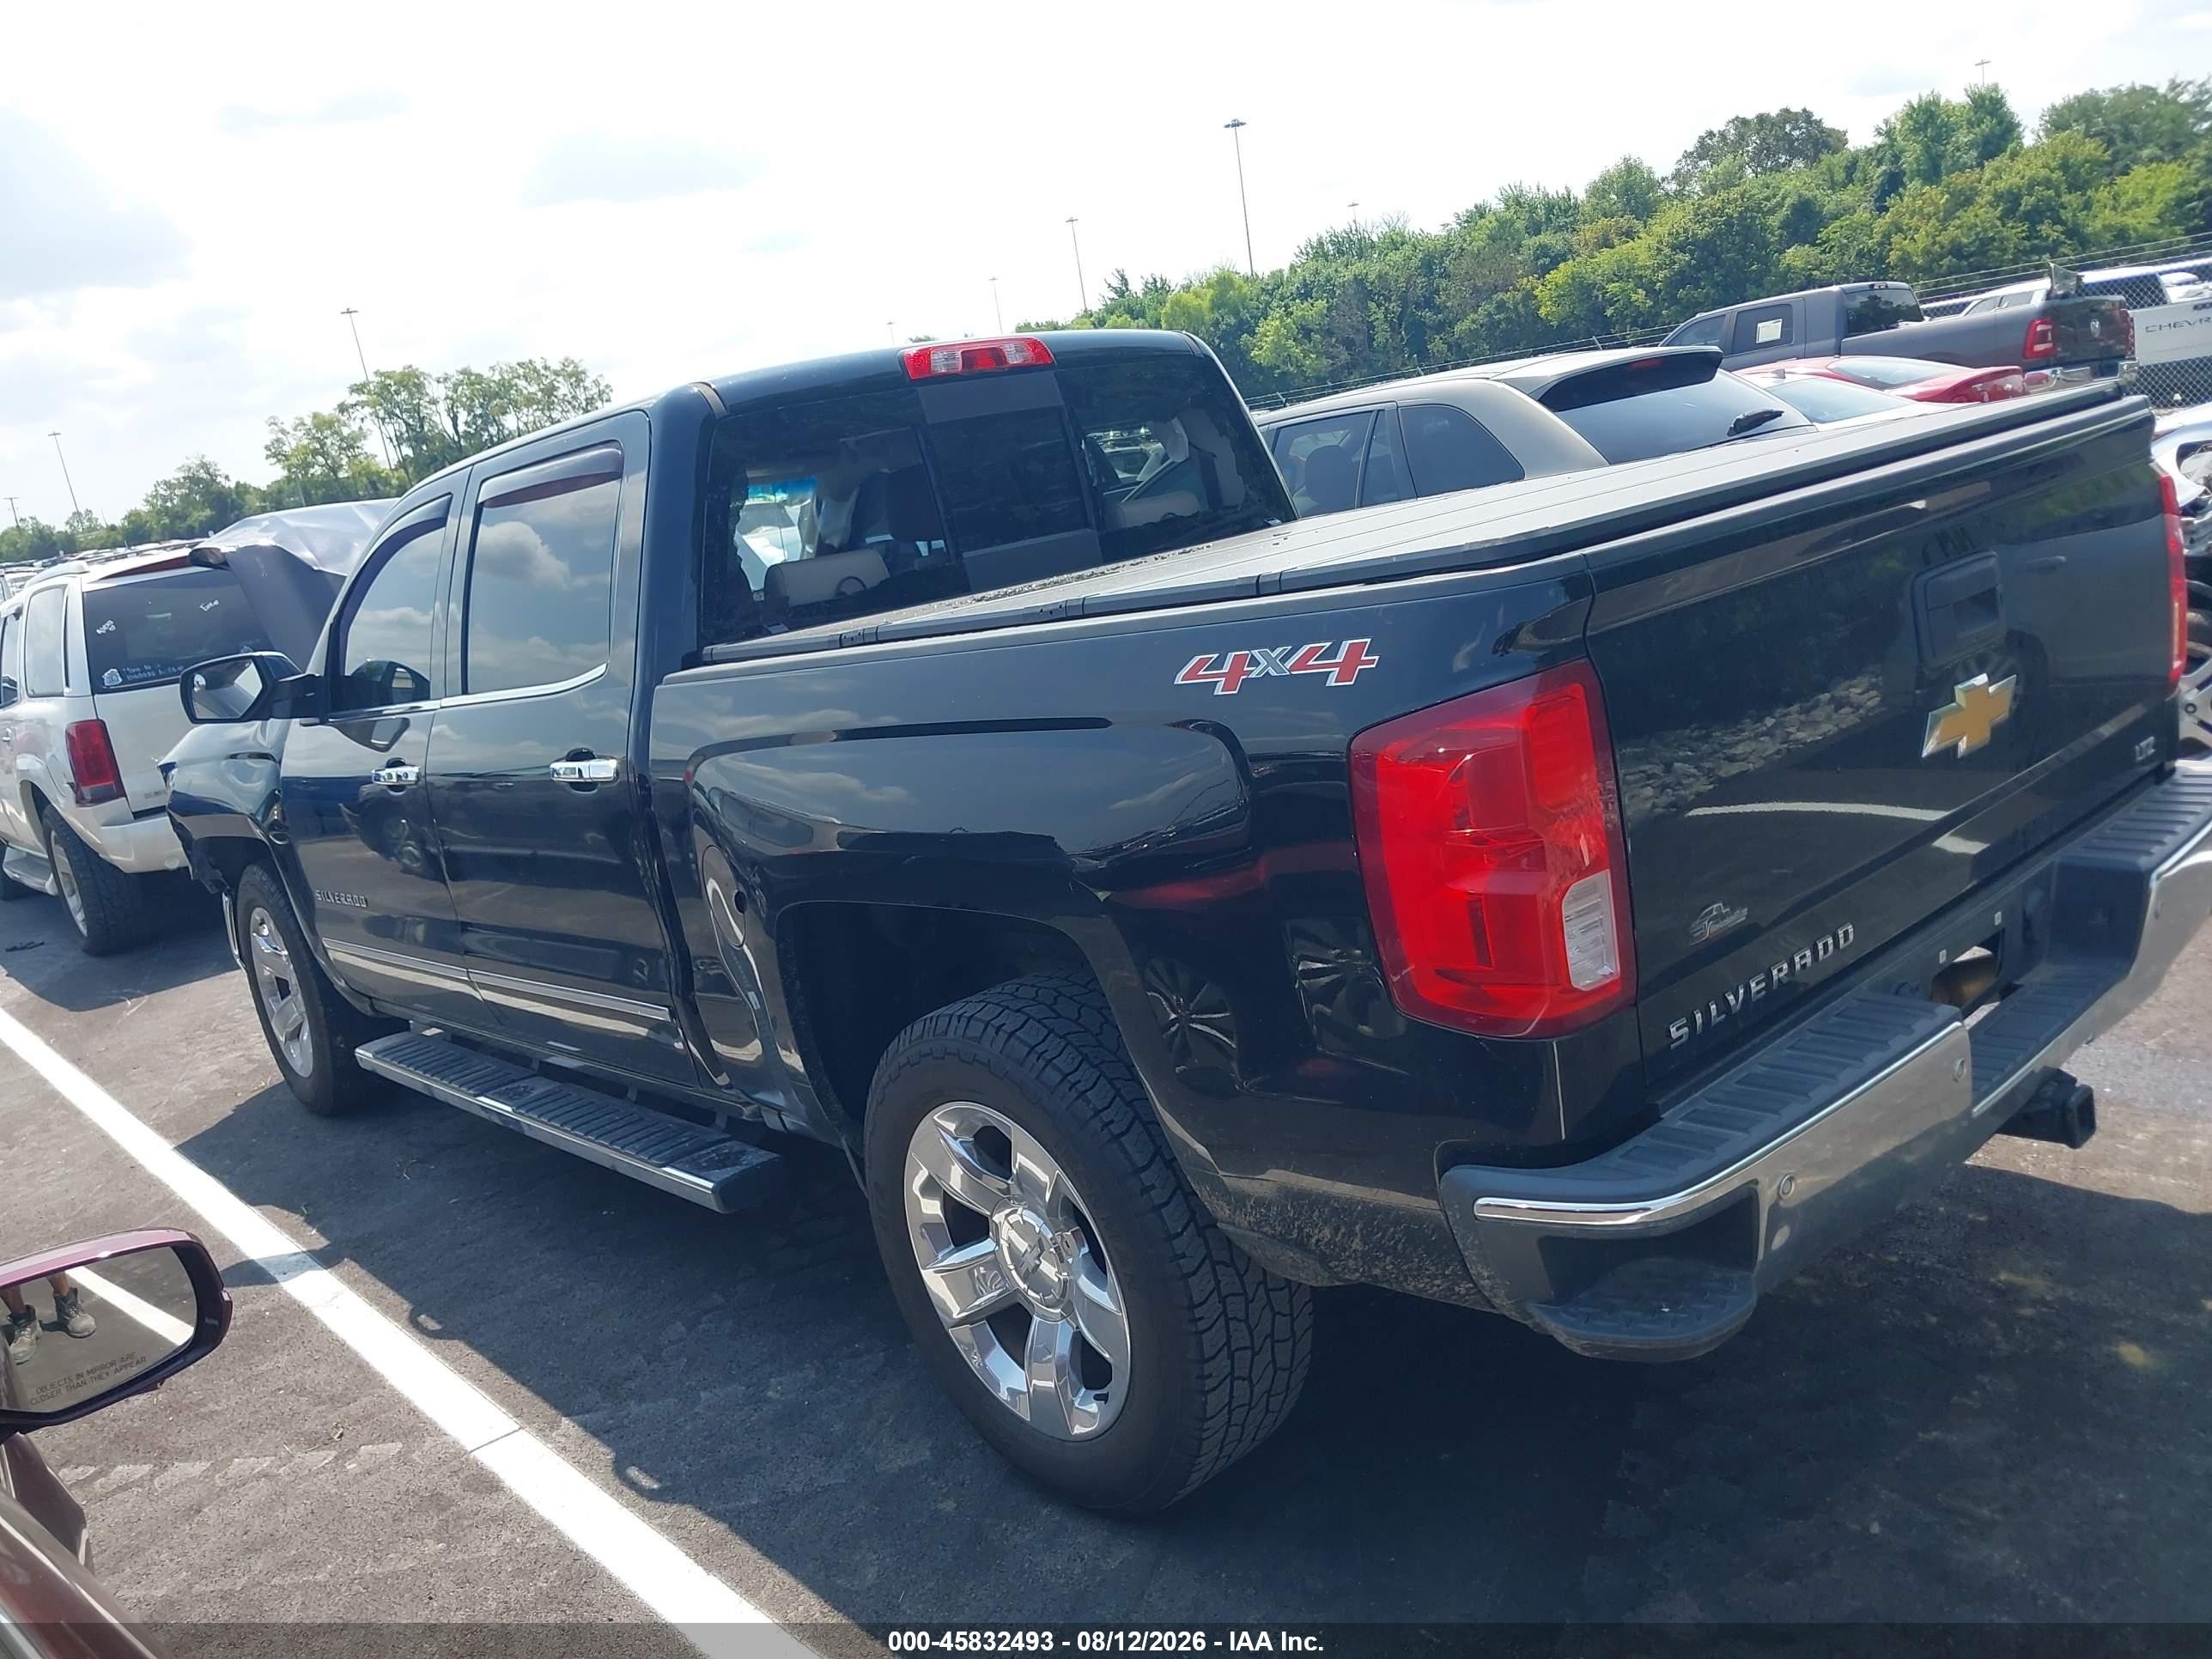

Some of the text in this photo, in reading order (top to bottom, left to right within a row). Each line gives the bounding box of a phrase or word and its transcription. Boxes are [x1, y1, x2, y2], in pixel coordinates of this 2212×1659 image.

[315, 890, 368, 908] SILVERADO
[1669, 921, 1854, 1049] SILVERADO
[29, 1356, 147, 1406] CLOSER THAN THEY APPEAR
[35, 1376, 74, 1395] OBJECTS
[86, 1360, 117, 1376] MIRROR
[119, 1352, 137, 1364] ARE
